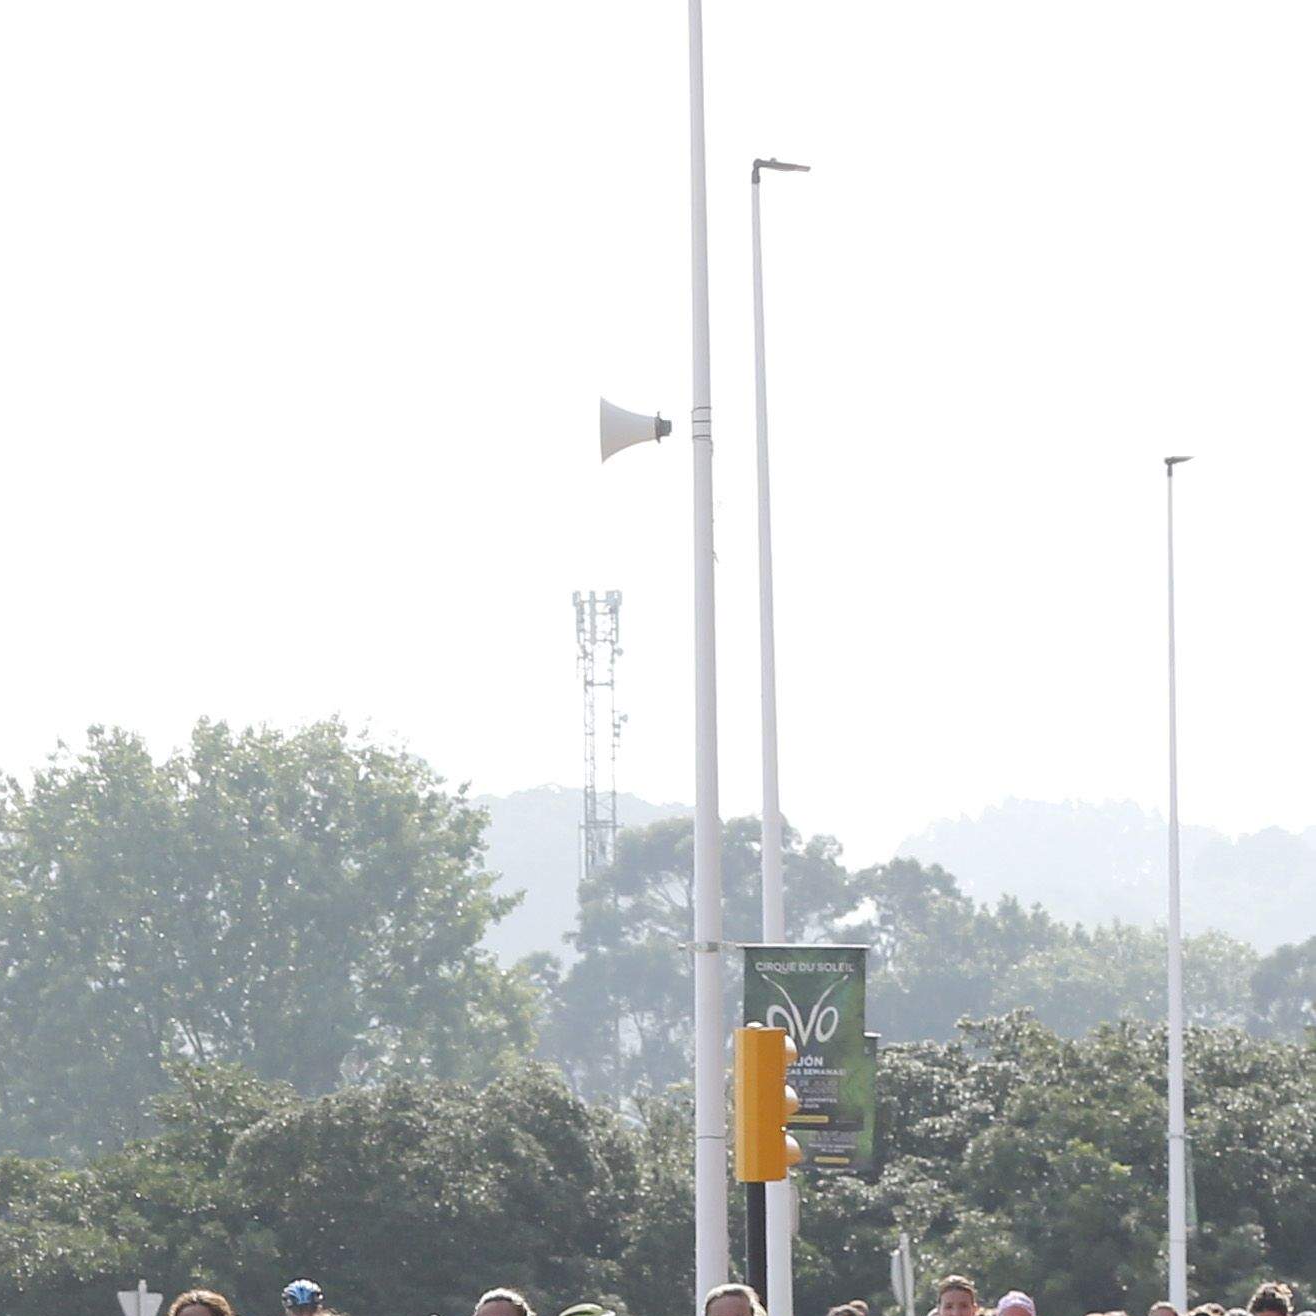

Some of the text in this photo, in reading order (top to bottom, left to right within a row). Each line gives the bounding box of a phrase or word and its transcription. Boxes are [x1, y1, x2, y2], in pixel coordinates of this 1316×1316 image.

[755, 962, 854, 975] CIRQUE DU SOLEIL
[764, 986, 843, 1046] OVO
